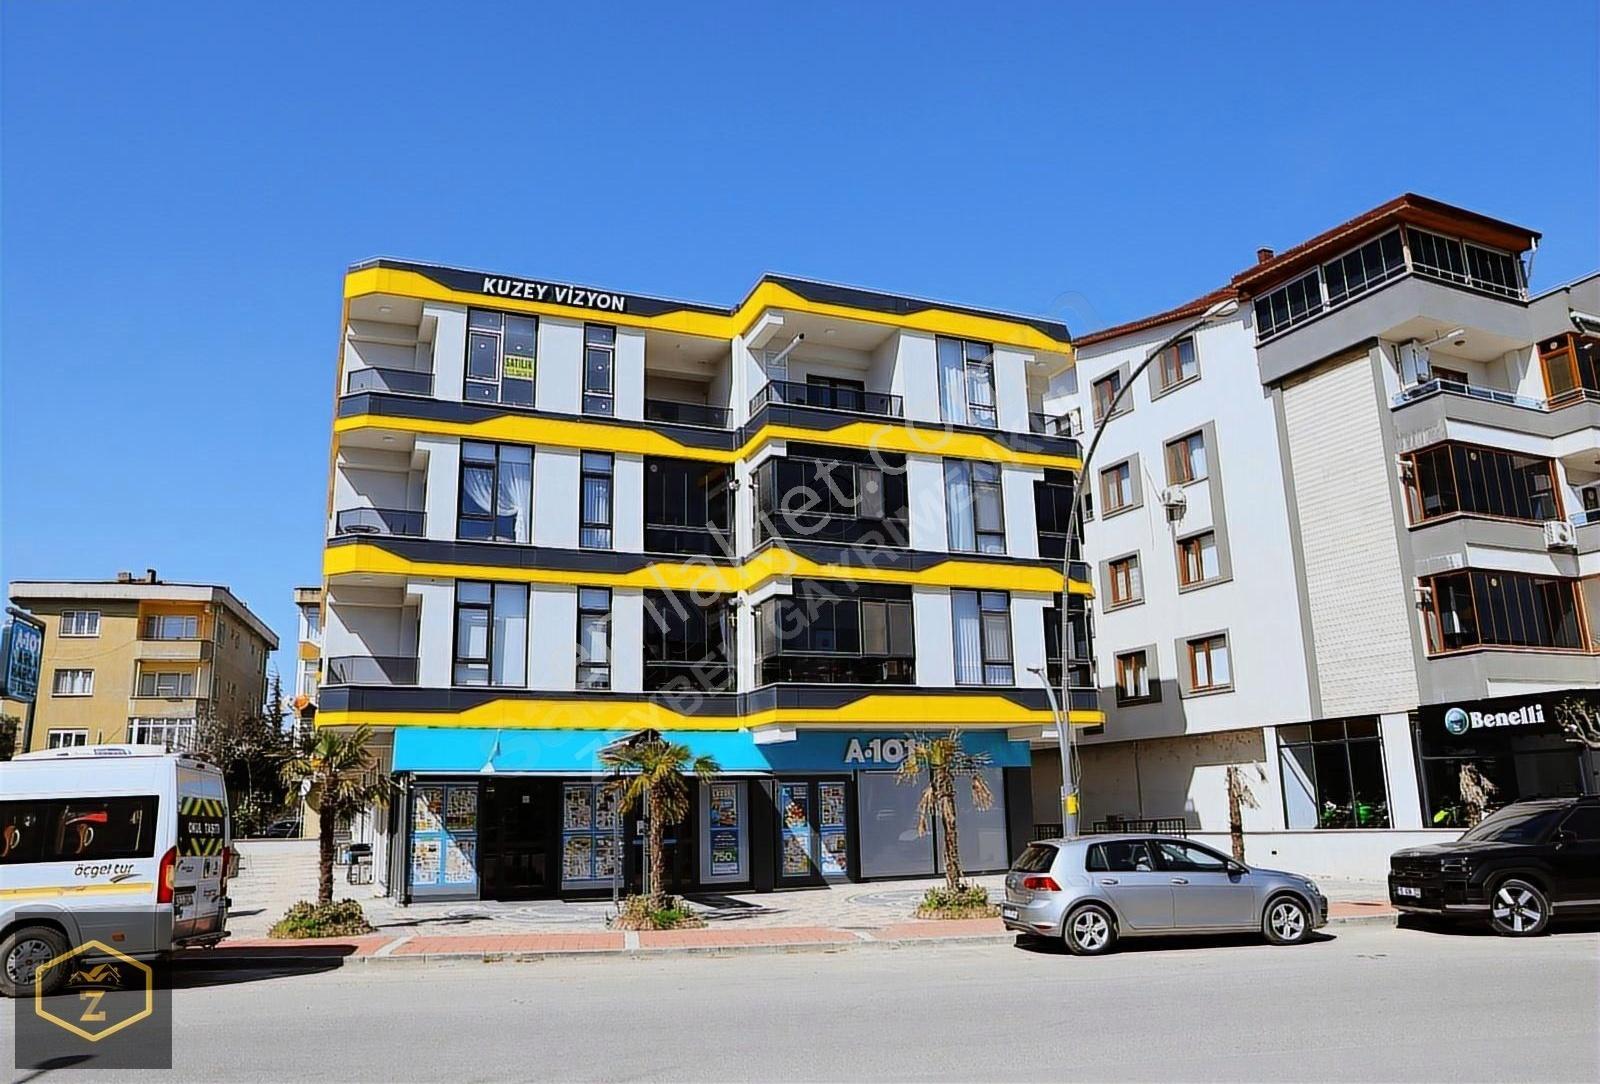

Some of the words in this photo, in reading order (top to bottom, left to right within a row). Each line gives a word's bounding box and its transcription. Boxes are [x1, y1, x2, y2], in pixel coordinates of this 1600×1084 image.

[483, 277, 548, 300] KUZEY
[555, 285, 625, 312] VİZYON
[1469, 704, 1545, 729] Benelli
[113, 864, 135, 874] tur
